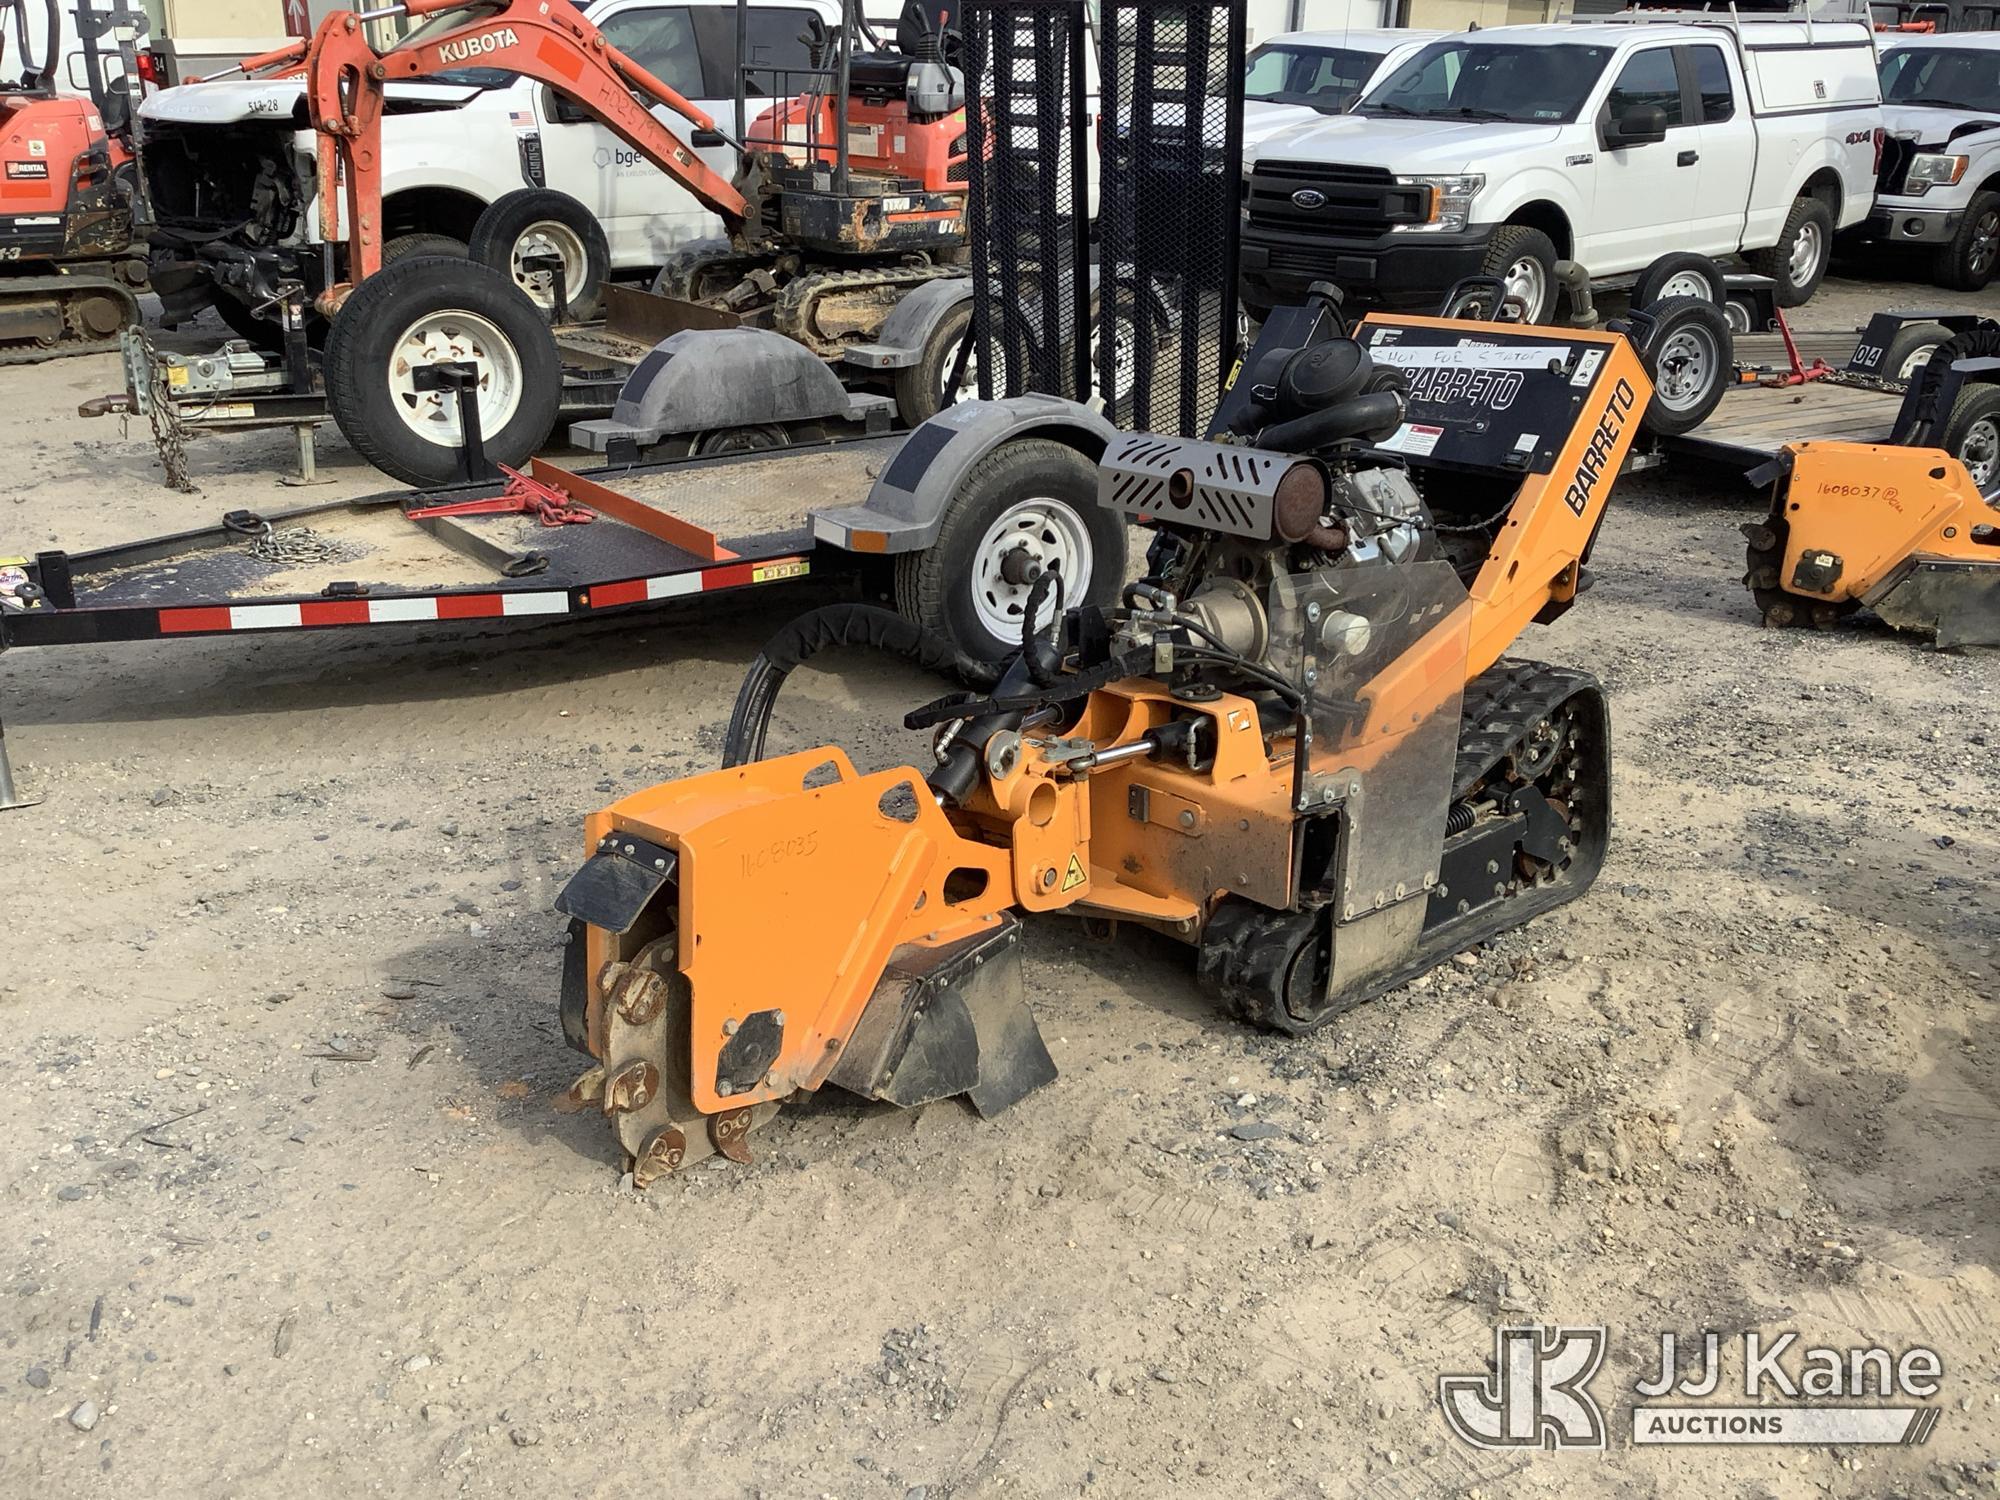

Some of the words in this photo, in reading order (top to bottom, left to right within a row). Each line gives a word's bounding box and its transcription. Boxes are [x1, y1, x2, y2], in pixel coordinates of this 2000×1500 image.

[439, 28, 519, 64] KUBOTA
[19, 163, 46, 172] RENTAL
[615, 149, 642, 168] bge
[1856, 346, 1880, 365] 04
[1402, 366, 1525, 411] BARRETO
[1565, 377, 1635, 519] BARRETO
[1817, 482, 1880, 498] 1608037
